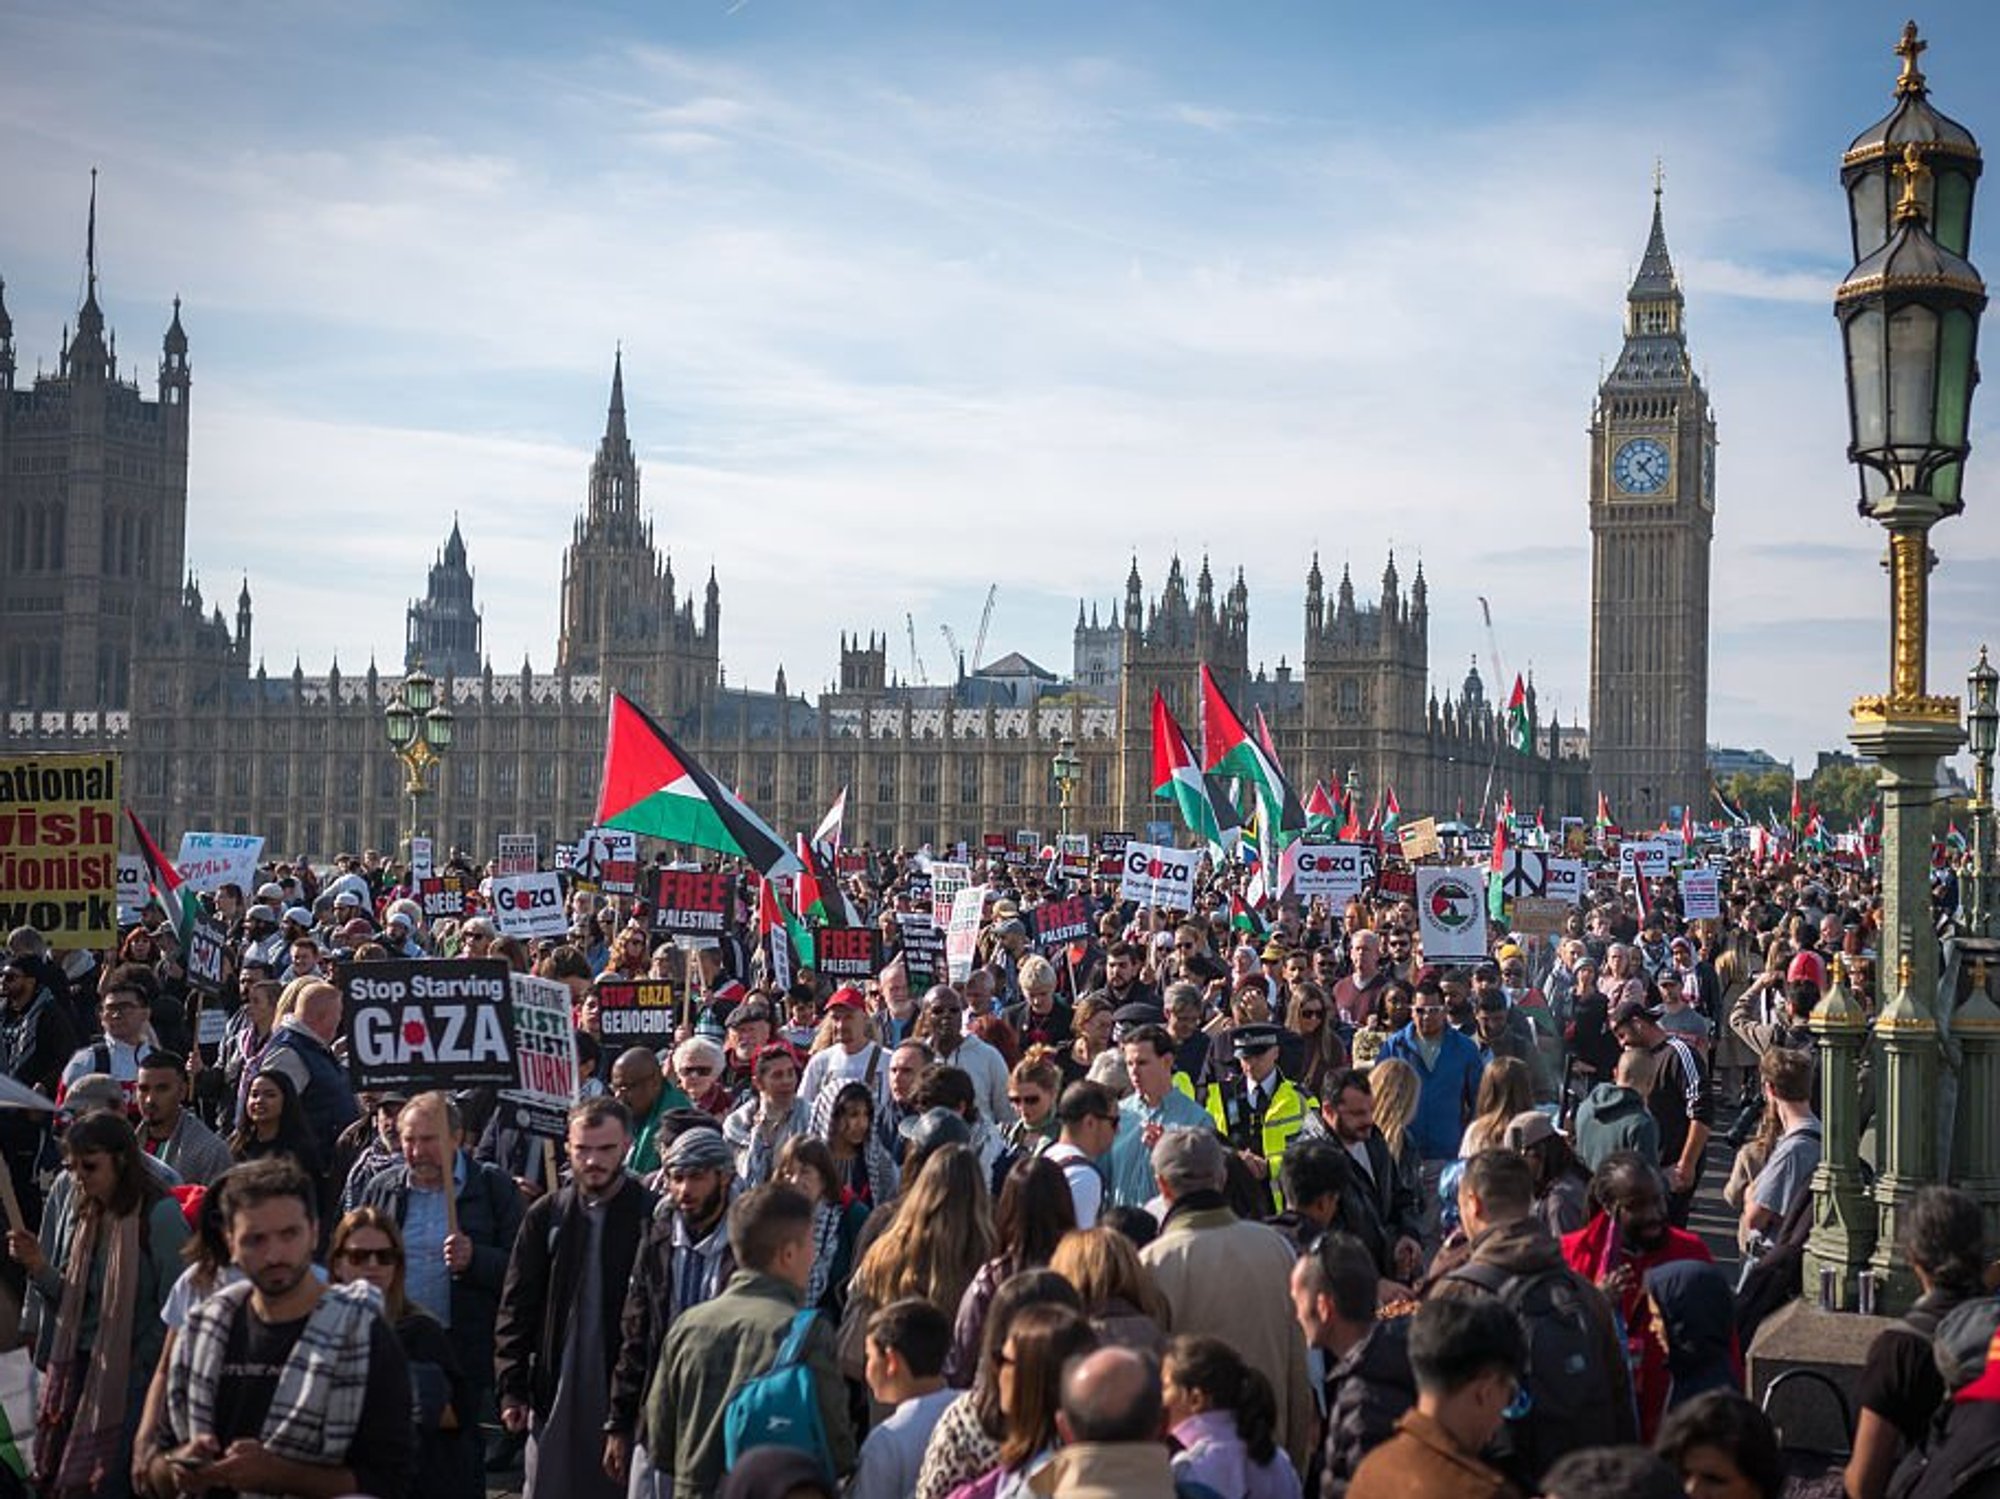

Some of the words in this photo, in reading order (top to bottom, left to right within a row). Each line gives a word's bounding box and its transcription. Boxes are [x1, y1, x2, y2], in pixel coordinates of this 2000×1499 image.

[0, 852, 113, 891] ionist
[424, 892, 463, 914] SIEGE
[659, 872, 728, 912] FREE
[656, 909, 724, 930] PALESTINE
[1036, 896, 1087, 933] FREE
[821, 929, 872, 961] FREE
[821, 959, 871, 974] PALESTINE
[351, 978, 405, 1002] Stop
[410, 974, 504, 1000] Starving
[638, 985, 672, 1006] GAZA
[354, 1004, 510, 1067] GAZA
[601, 1009, 673, 1034] GENOCIDE
